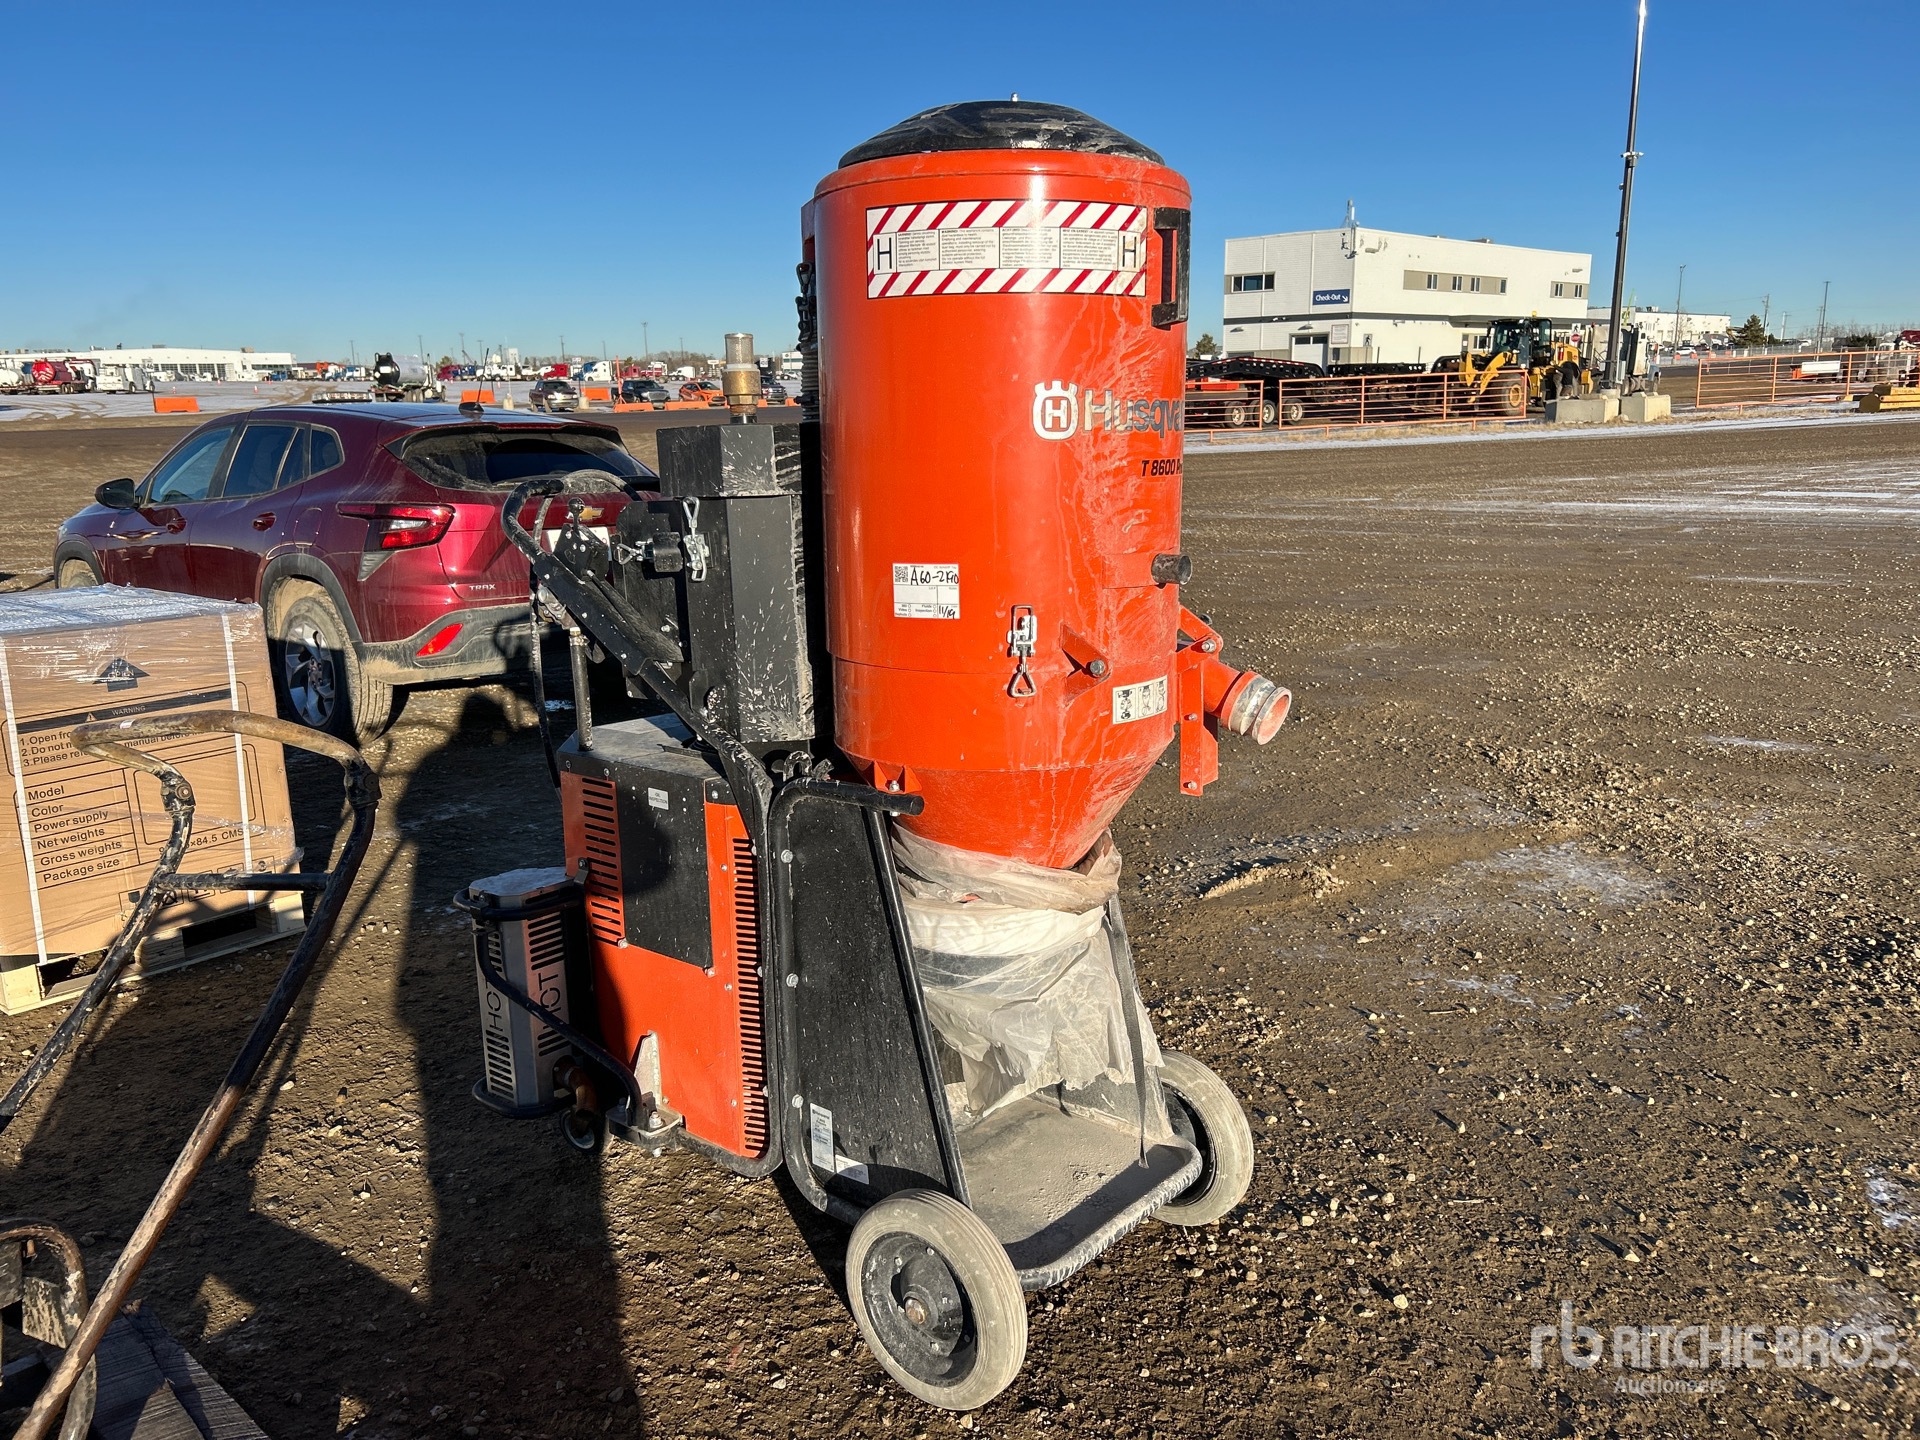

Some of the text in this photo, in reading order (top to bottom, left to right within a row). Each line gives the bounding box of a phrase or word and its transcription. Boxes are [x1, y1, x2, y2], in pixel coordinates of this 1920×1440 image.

[877, 236, 893, 271] H
[1121, 235, 1138, 269] H
[1315, 293, 1341, 302] Check-Out
[1141, 459, 1150, 477] T
[1150, 458, 1176, 477] 8600
[468, 583, 497, 591] TRAX
[111, 705, 146, 717] WARNING
[58, 730, 72, 740] fro
[123, 736, 159, 748] manual
[47, 742, 65, 753] not
[27, 785, 65, 801] Model
[31, 804, 64, 818] Color
[33, 810, 109, 833] Power supply
[37, 828, 106, 850] Net weights
[221, 828, 244, 840] CMS
[40, 841, 122, 866] Gross weights
[43, 858, 120, 883] Package size
